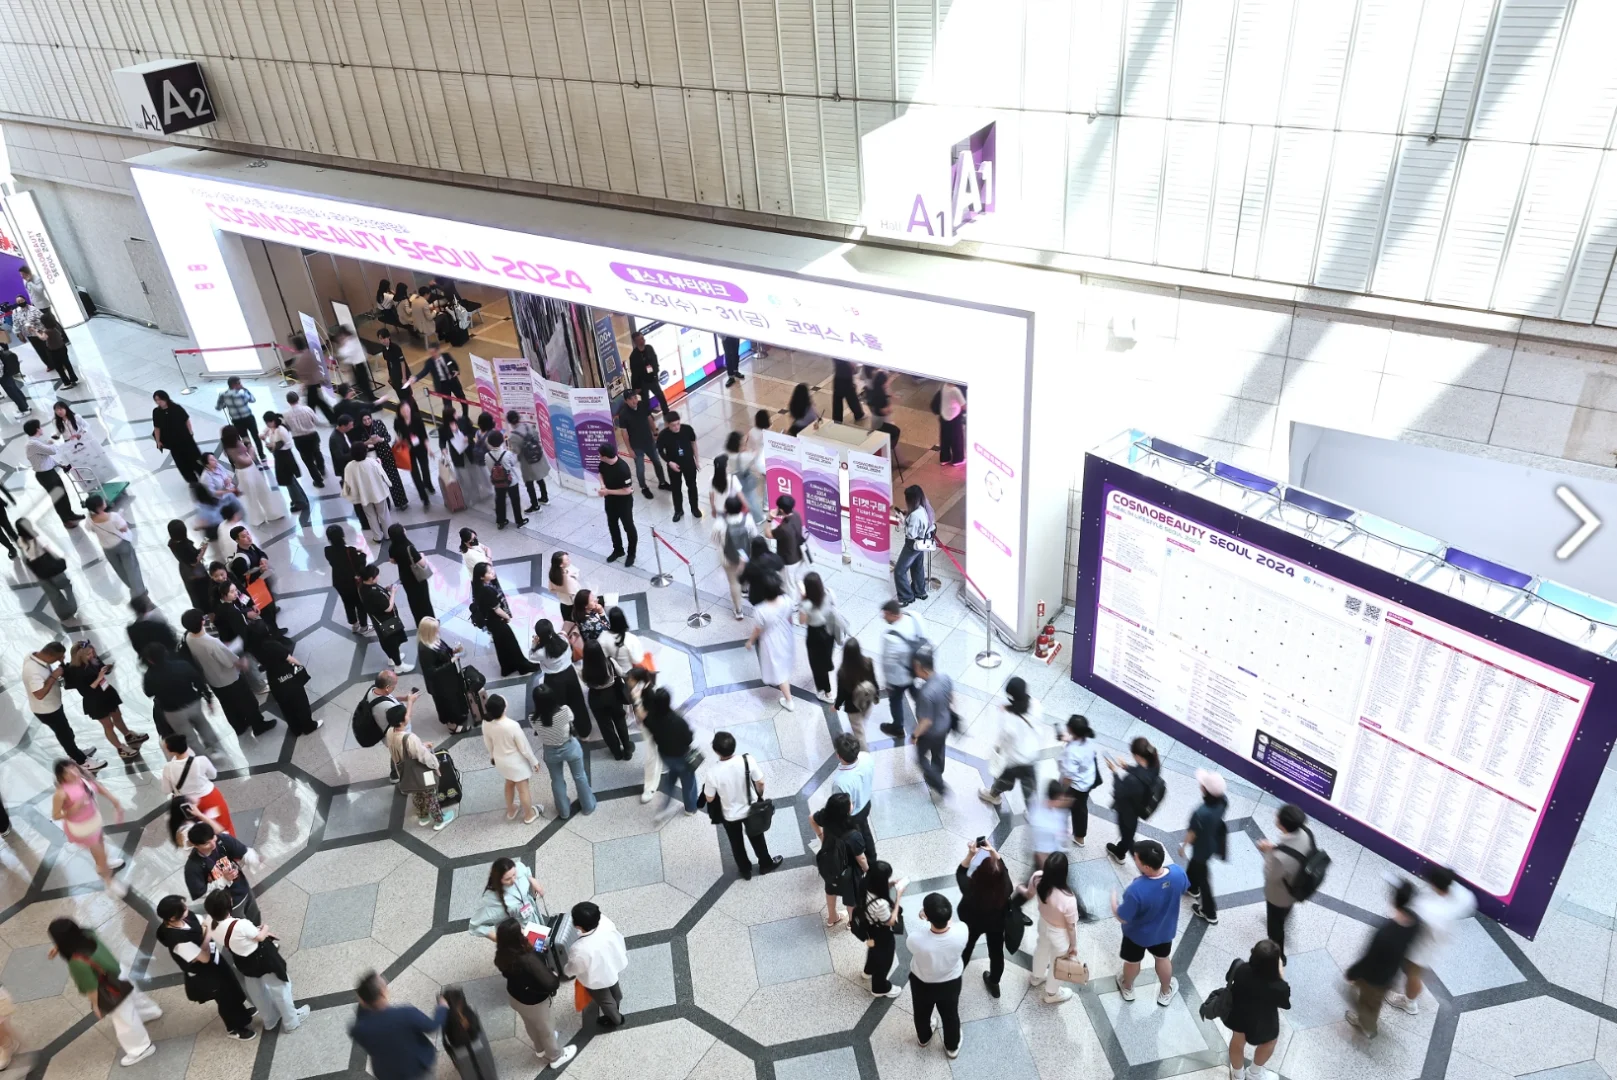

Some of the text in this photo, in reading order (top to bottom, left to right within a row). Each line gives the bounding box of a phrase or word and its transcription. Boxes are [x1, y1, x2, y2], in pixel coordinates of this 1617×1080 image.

[141, 104, 162, 131] A2
[162, 79, 211, 126] A2
[952, 149, 993, 231] A1
[880, 193, 945, 238] Hall A1
[27, 230, 56, 285] COSMOBEAUTY
[204, 202, 396, 256] COSMOBEAUTY
[393, 237, 501, 276] SEOUL
[491, 255, 593, 294] 2024
[785, 318, 884, 351] 코엑스 A홀
[852, 496, 887, 513] 티켓구매
[1113, 493, 1206, 539] COSMOBEAUTY
[1209, 534, 1253, 560] SEOUL
[1256, 553, 1295, 578] 2024
